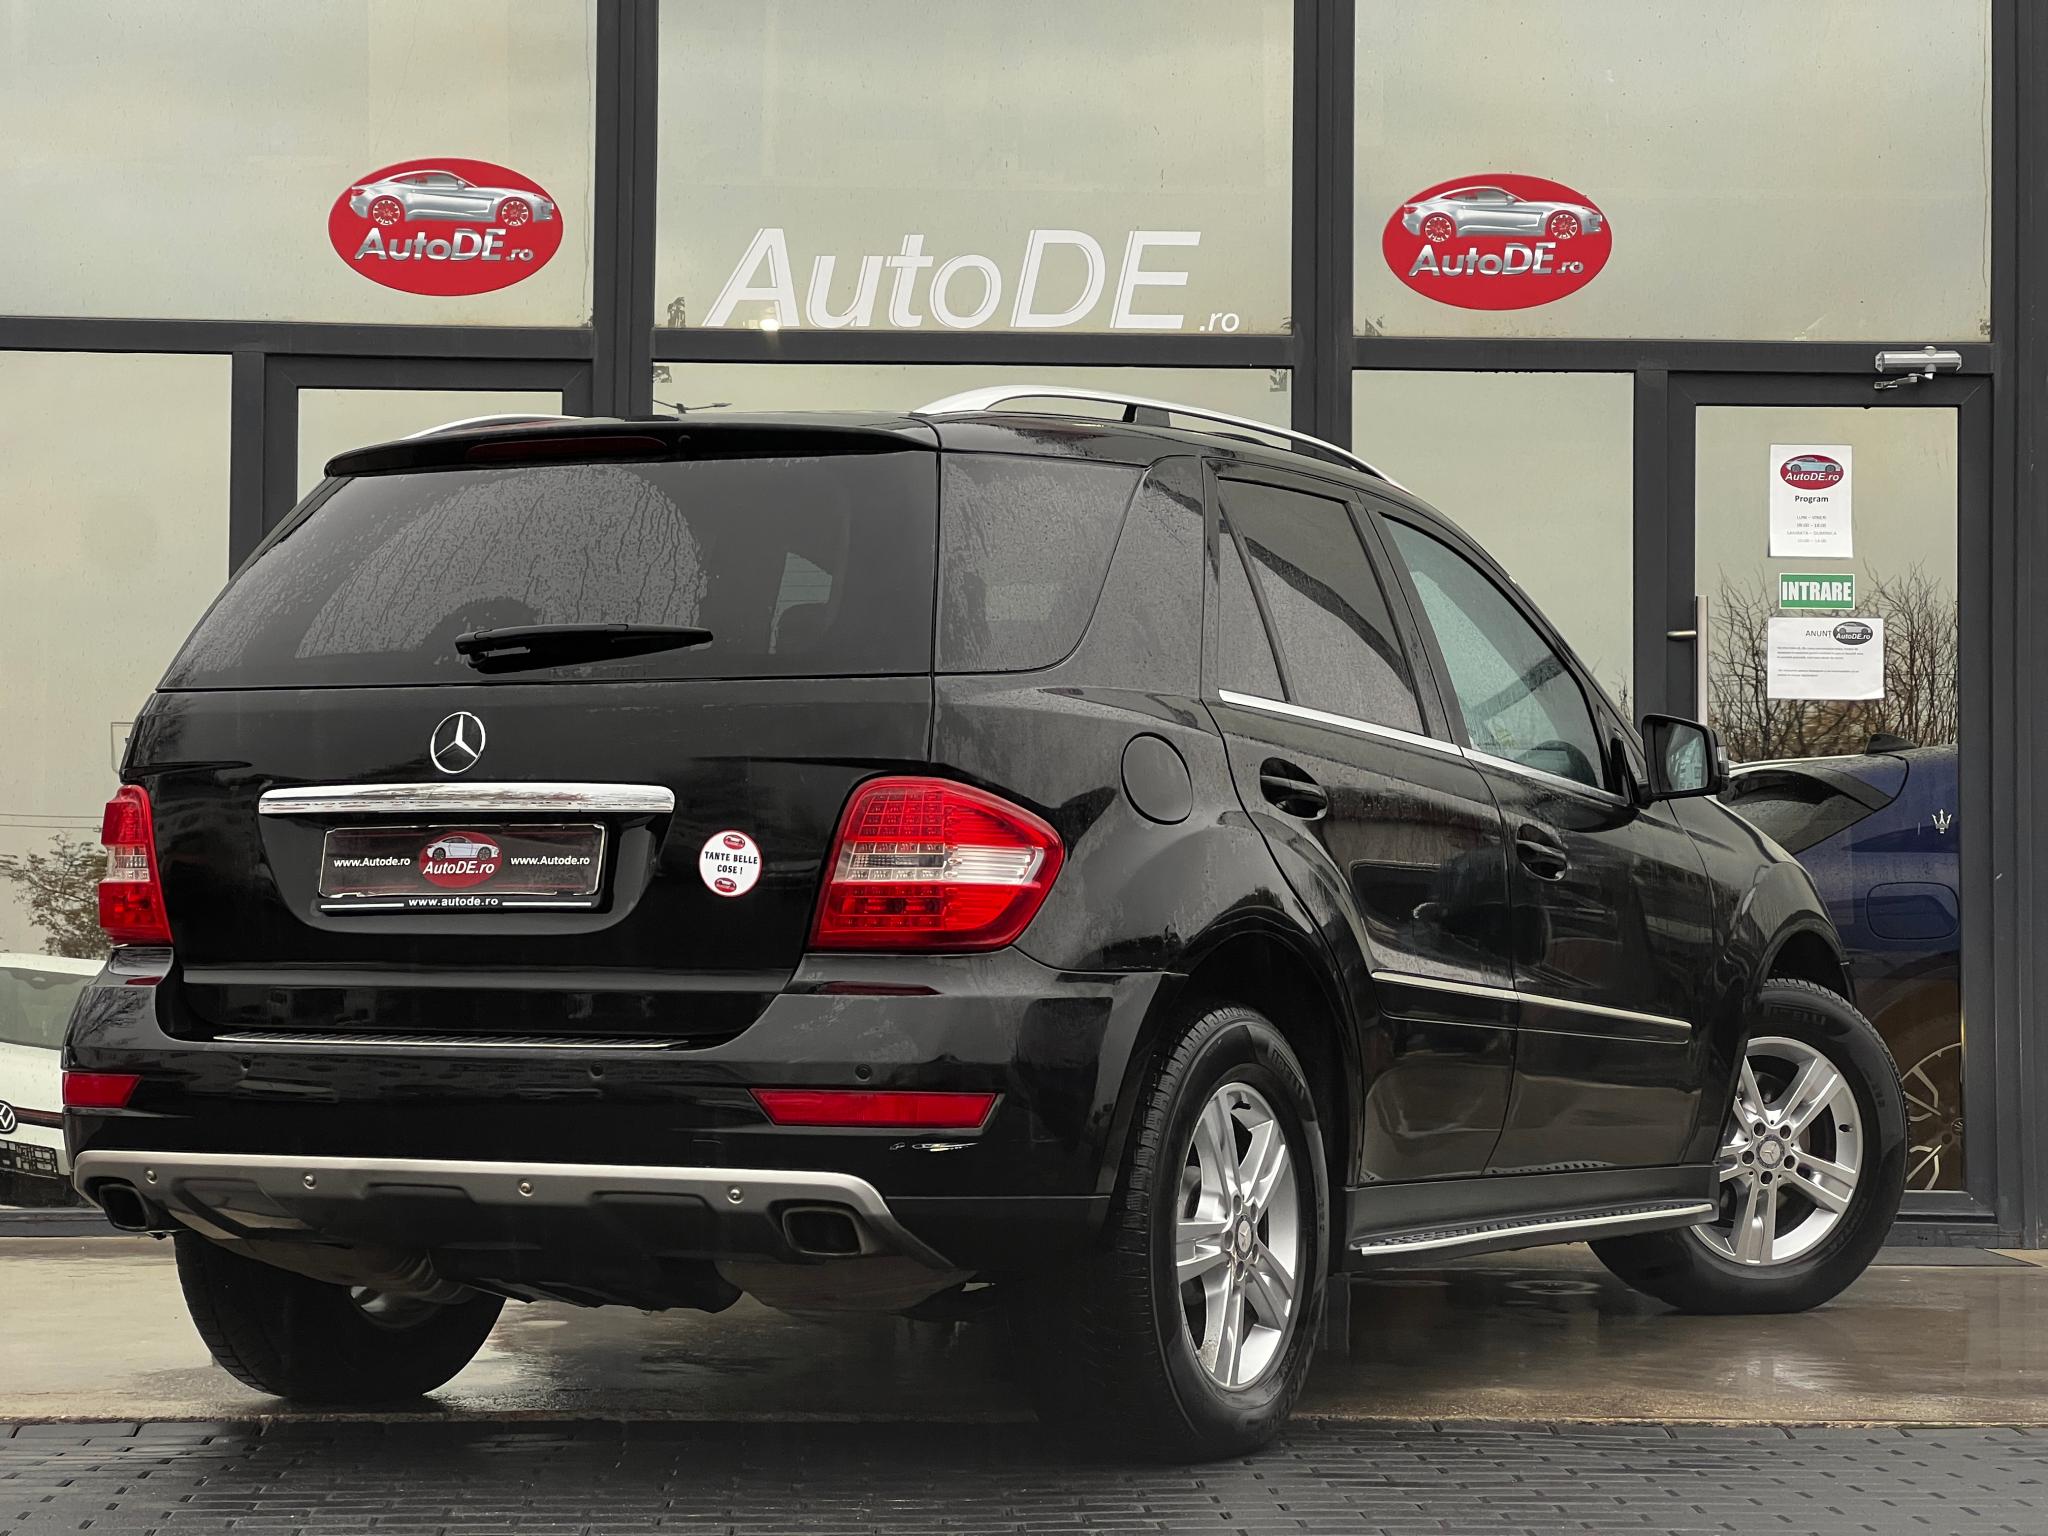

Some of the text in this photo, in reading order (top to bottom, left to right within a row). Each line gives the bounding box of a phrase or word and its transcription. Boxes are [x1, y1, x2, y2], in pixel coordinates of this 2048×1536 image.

[354, 227, 534, 262] AutoDE.ro
[1408, 241, 1585, 277] AutoDE.ro
[1785, 472, 1840, 483] AutoDE.ro
[1795, 495, 1829, 504] Program
[1782, 581, 1852, 601] INTRARE
[1836, 632, 1871, 640] AutoDE.ro
[334, 856, 411, 868] www.Autode.ro
[510, 855, 591, 866] www.Autode.ro
[704, 851, 758, 865] TANTE BELLE
[422, 860, 496, 875] AutoDE.ro
[717, 864, 738, 874] COSE
[408, 895, 499, 907] www.autode.ro
